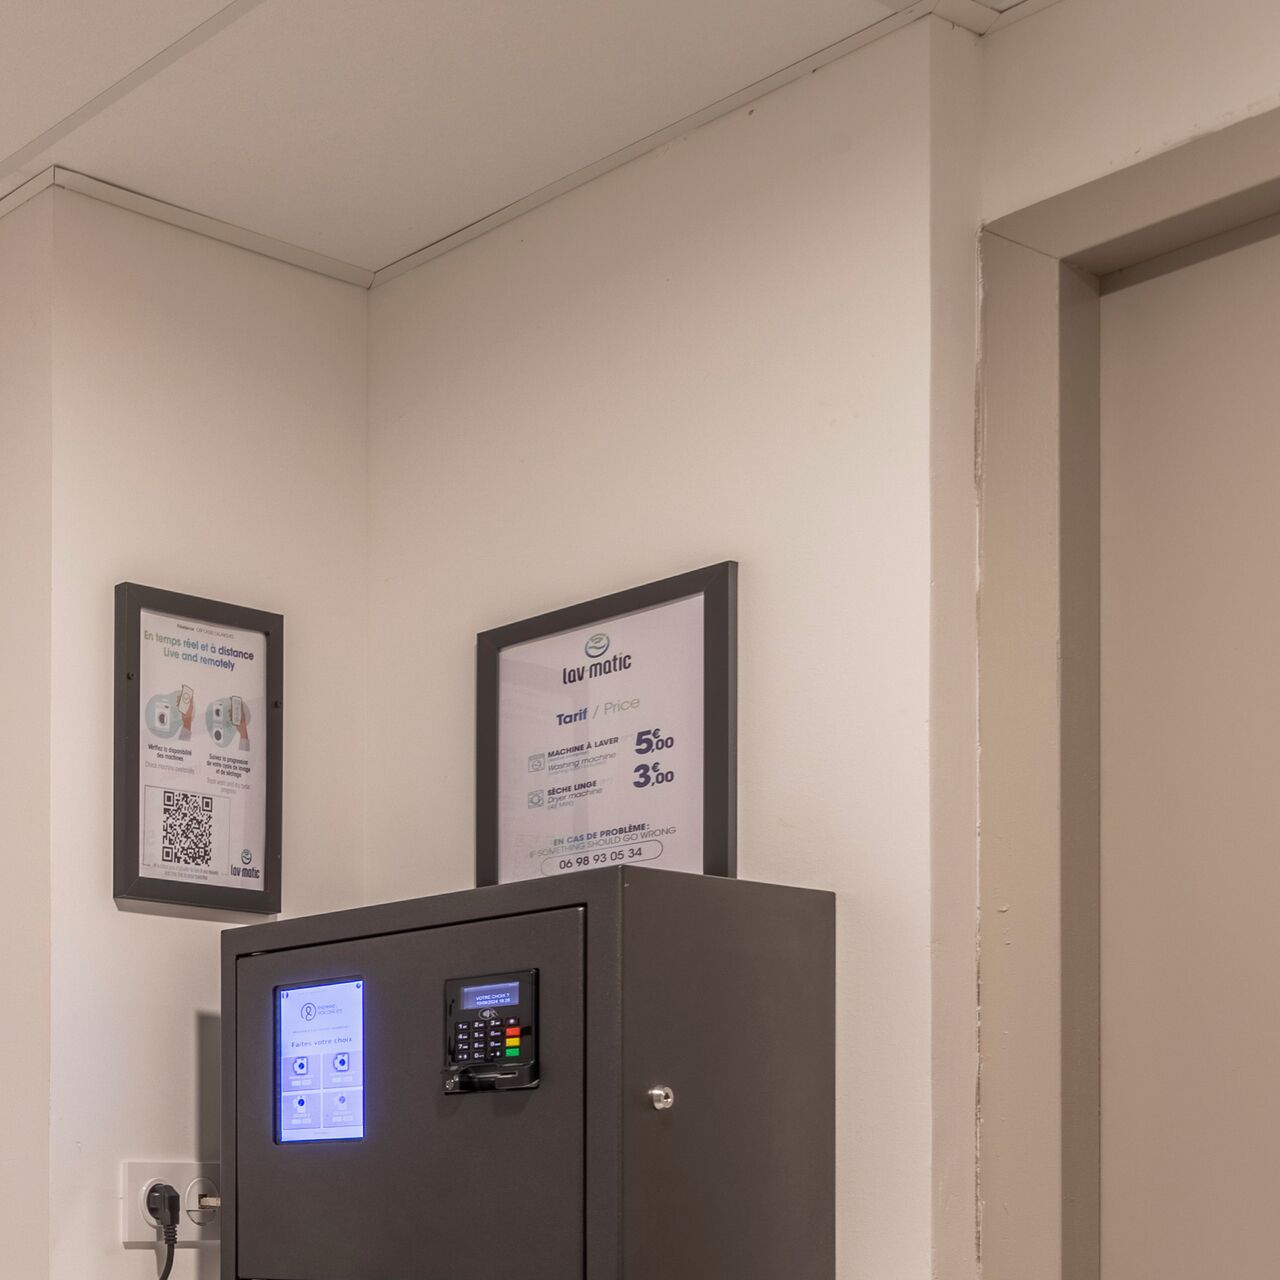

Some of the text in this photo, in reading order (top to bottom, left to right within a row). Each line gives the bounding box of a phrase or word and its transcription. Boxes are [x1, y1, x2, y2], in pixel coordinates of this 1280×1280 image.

[144, 630, 254, 661] En temps réel et à distance
[164, 647, 235, 671] Live and remotely
[557, 698, 640, 726] Tarif / Price
[548, 744, 585, 758] MACHINE
[595, 737, 619, 748] LAVER
[548, 760, 580, 772] Washing
[581, 752, 616, 766] machine
[574, 780, 597, 791] LINGE
[553, 838, 564, 846] EN
[567, 835, 585, 843] CAS
[559, 848, 642, 870] 06 98 93 05 34
[291, 1036, 353, 1048] Faites votre choix
